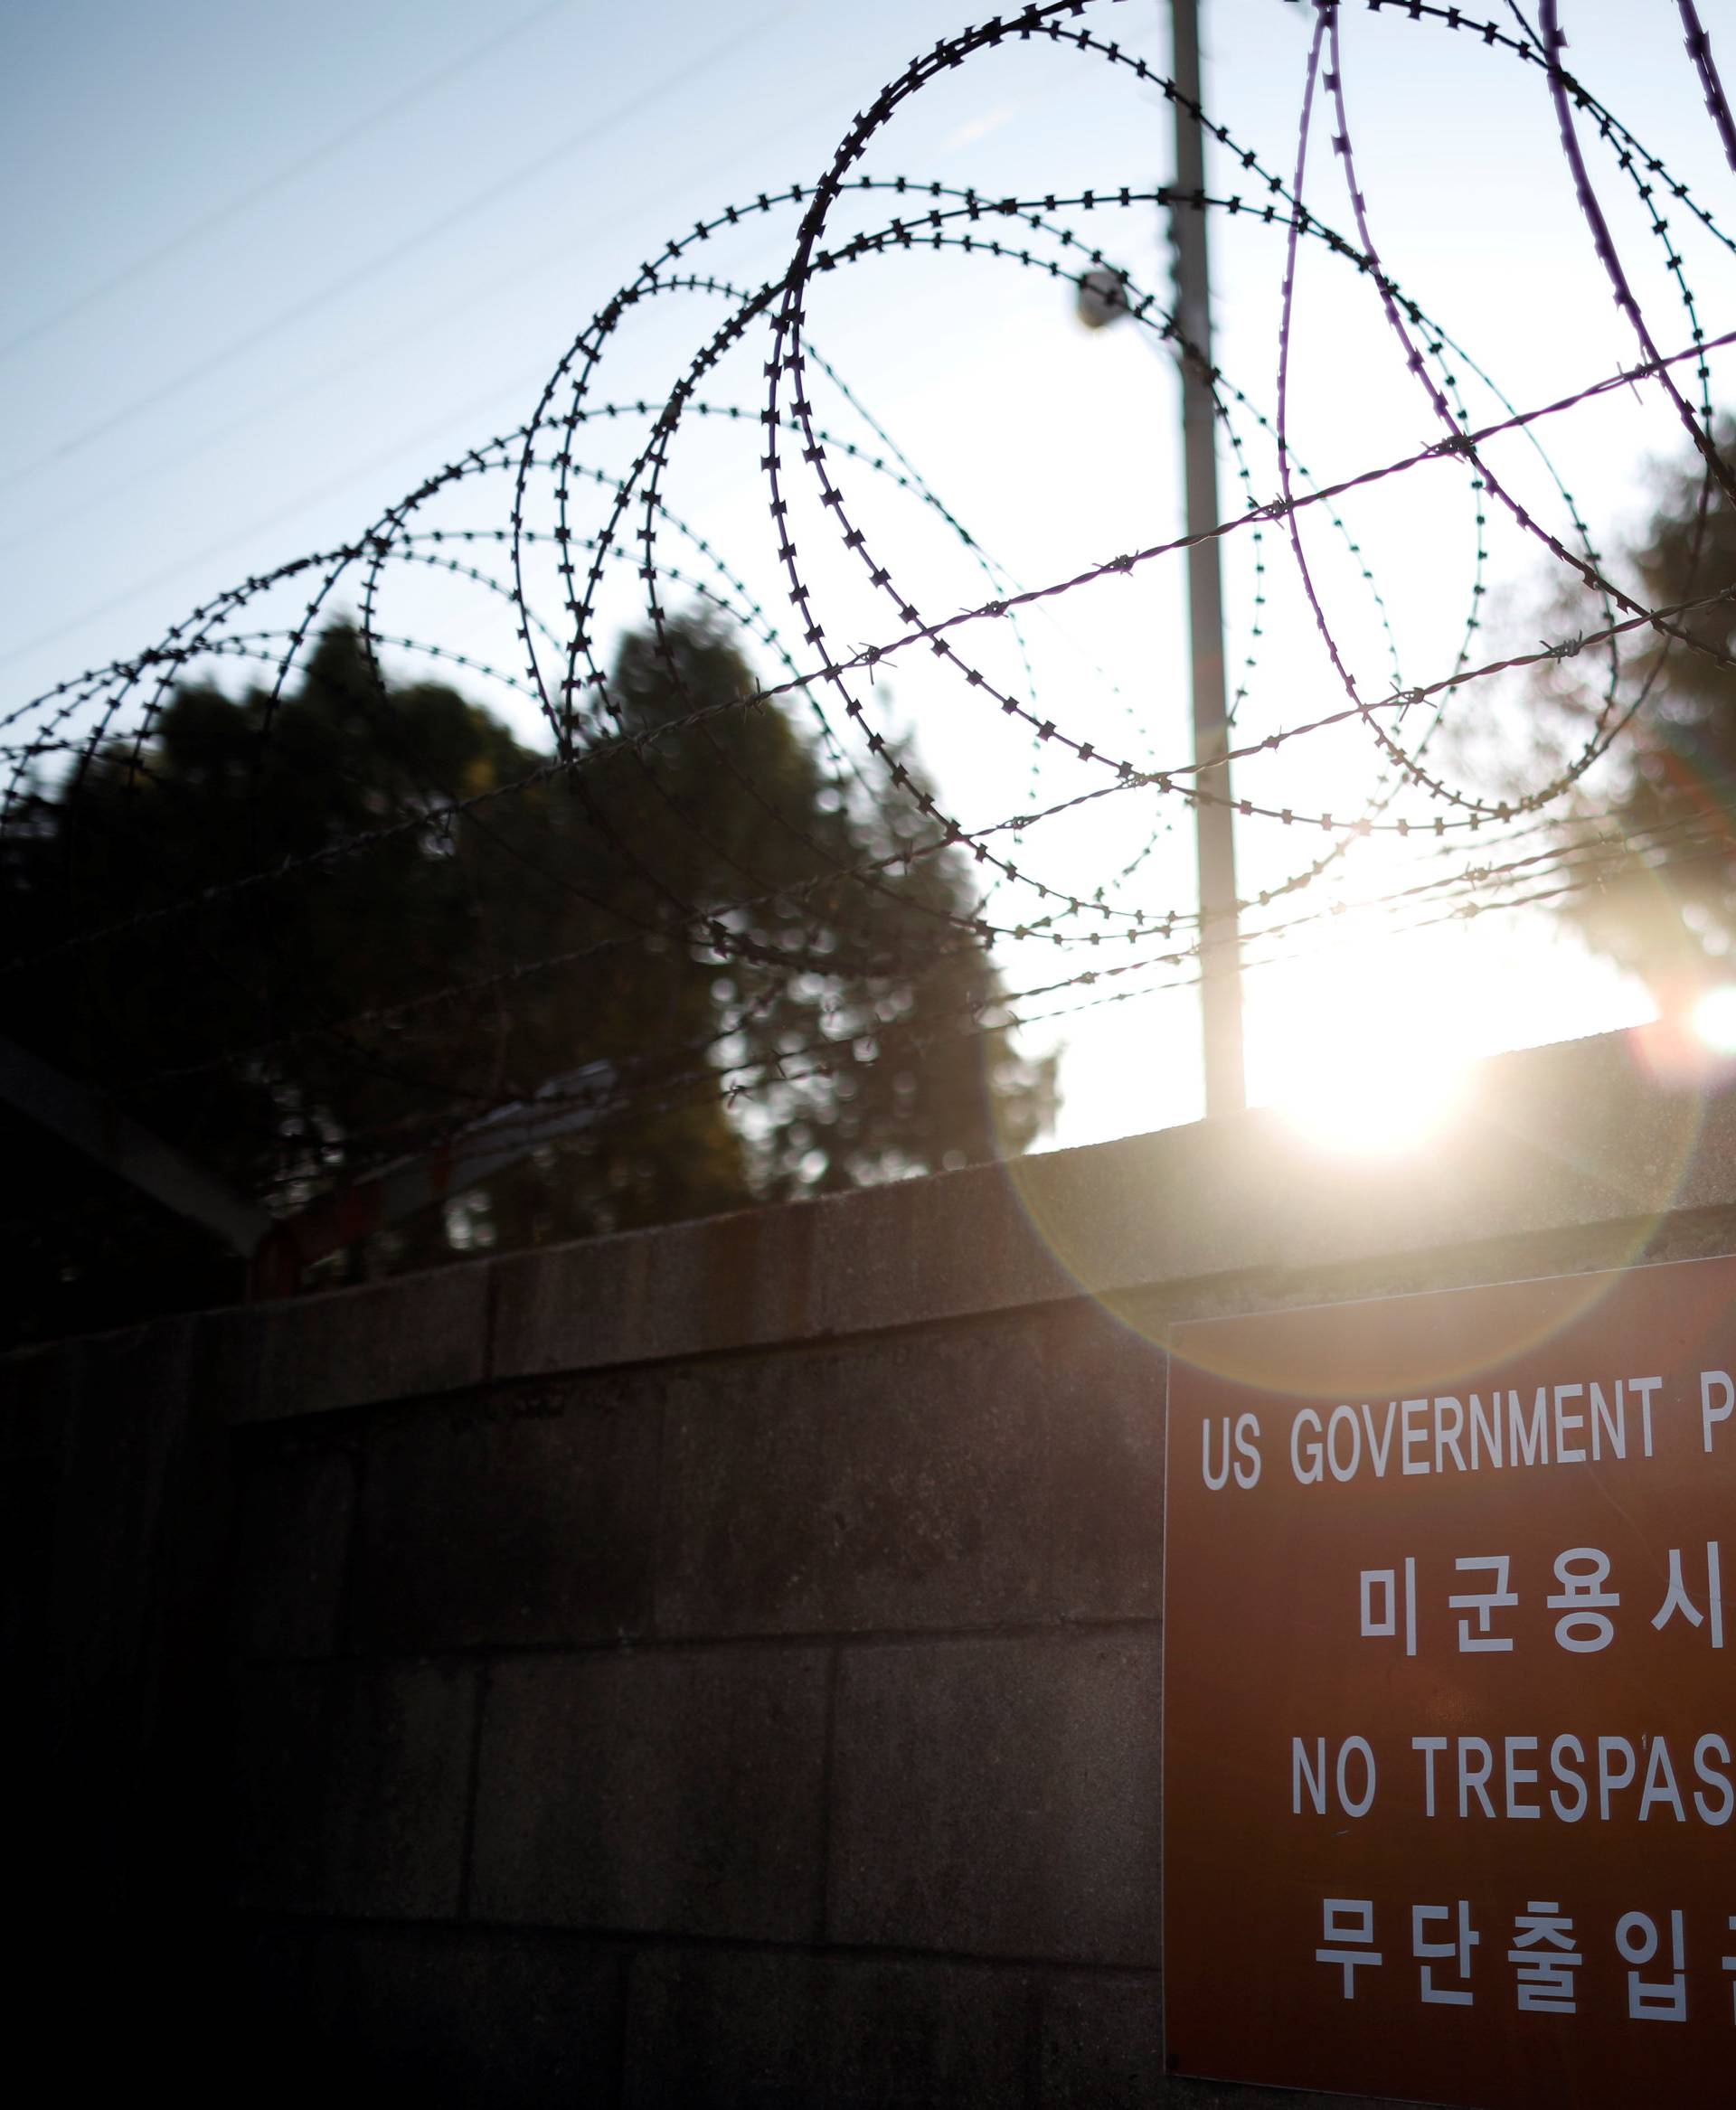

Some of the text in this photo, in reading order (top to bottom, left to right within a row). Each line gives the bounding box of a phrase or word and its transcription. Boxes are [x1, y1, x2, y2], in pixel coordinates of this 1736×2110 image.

[1203, 1370, 1736, 1490] US GOVERNMENT P
[1360, 1540, 1723, 1656] 미군용시
[1292, 1733, 1734, 1825] NO TRESPAS
[1316, 1898, 1736, 2025] 무단출입
